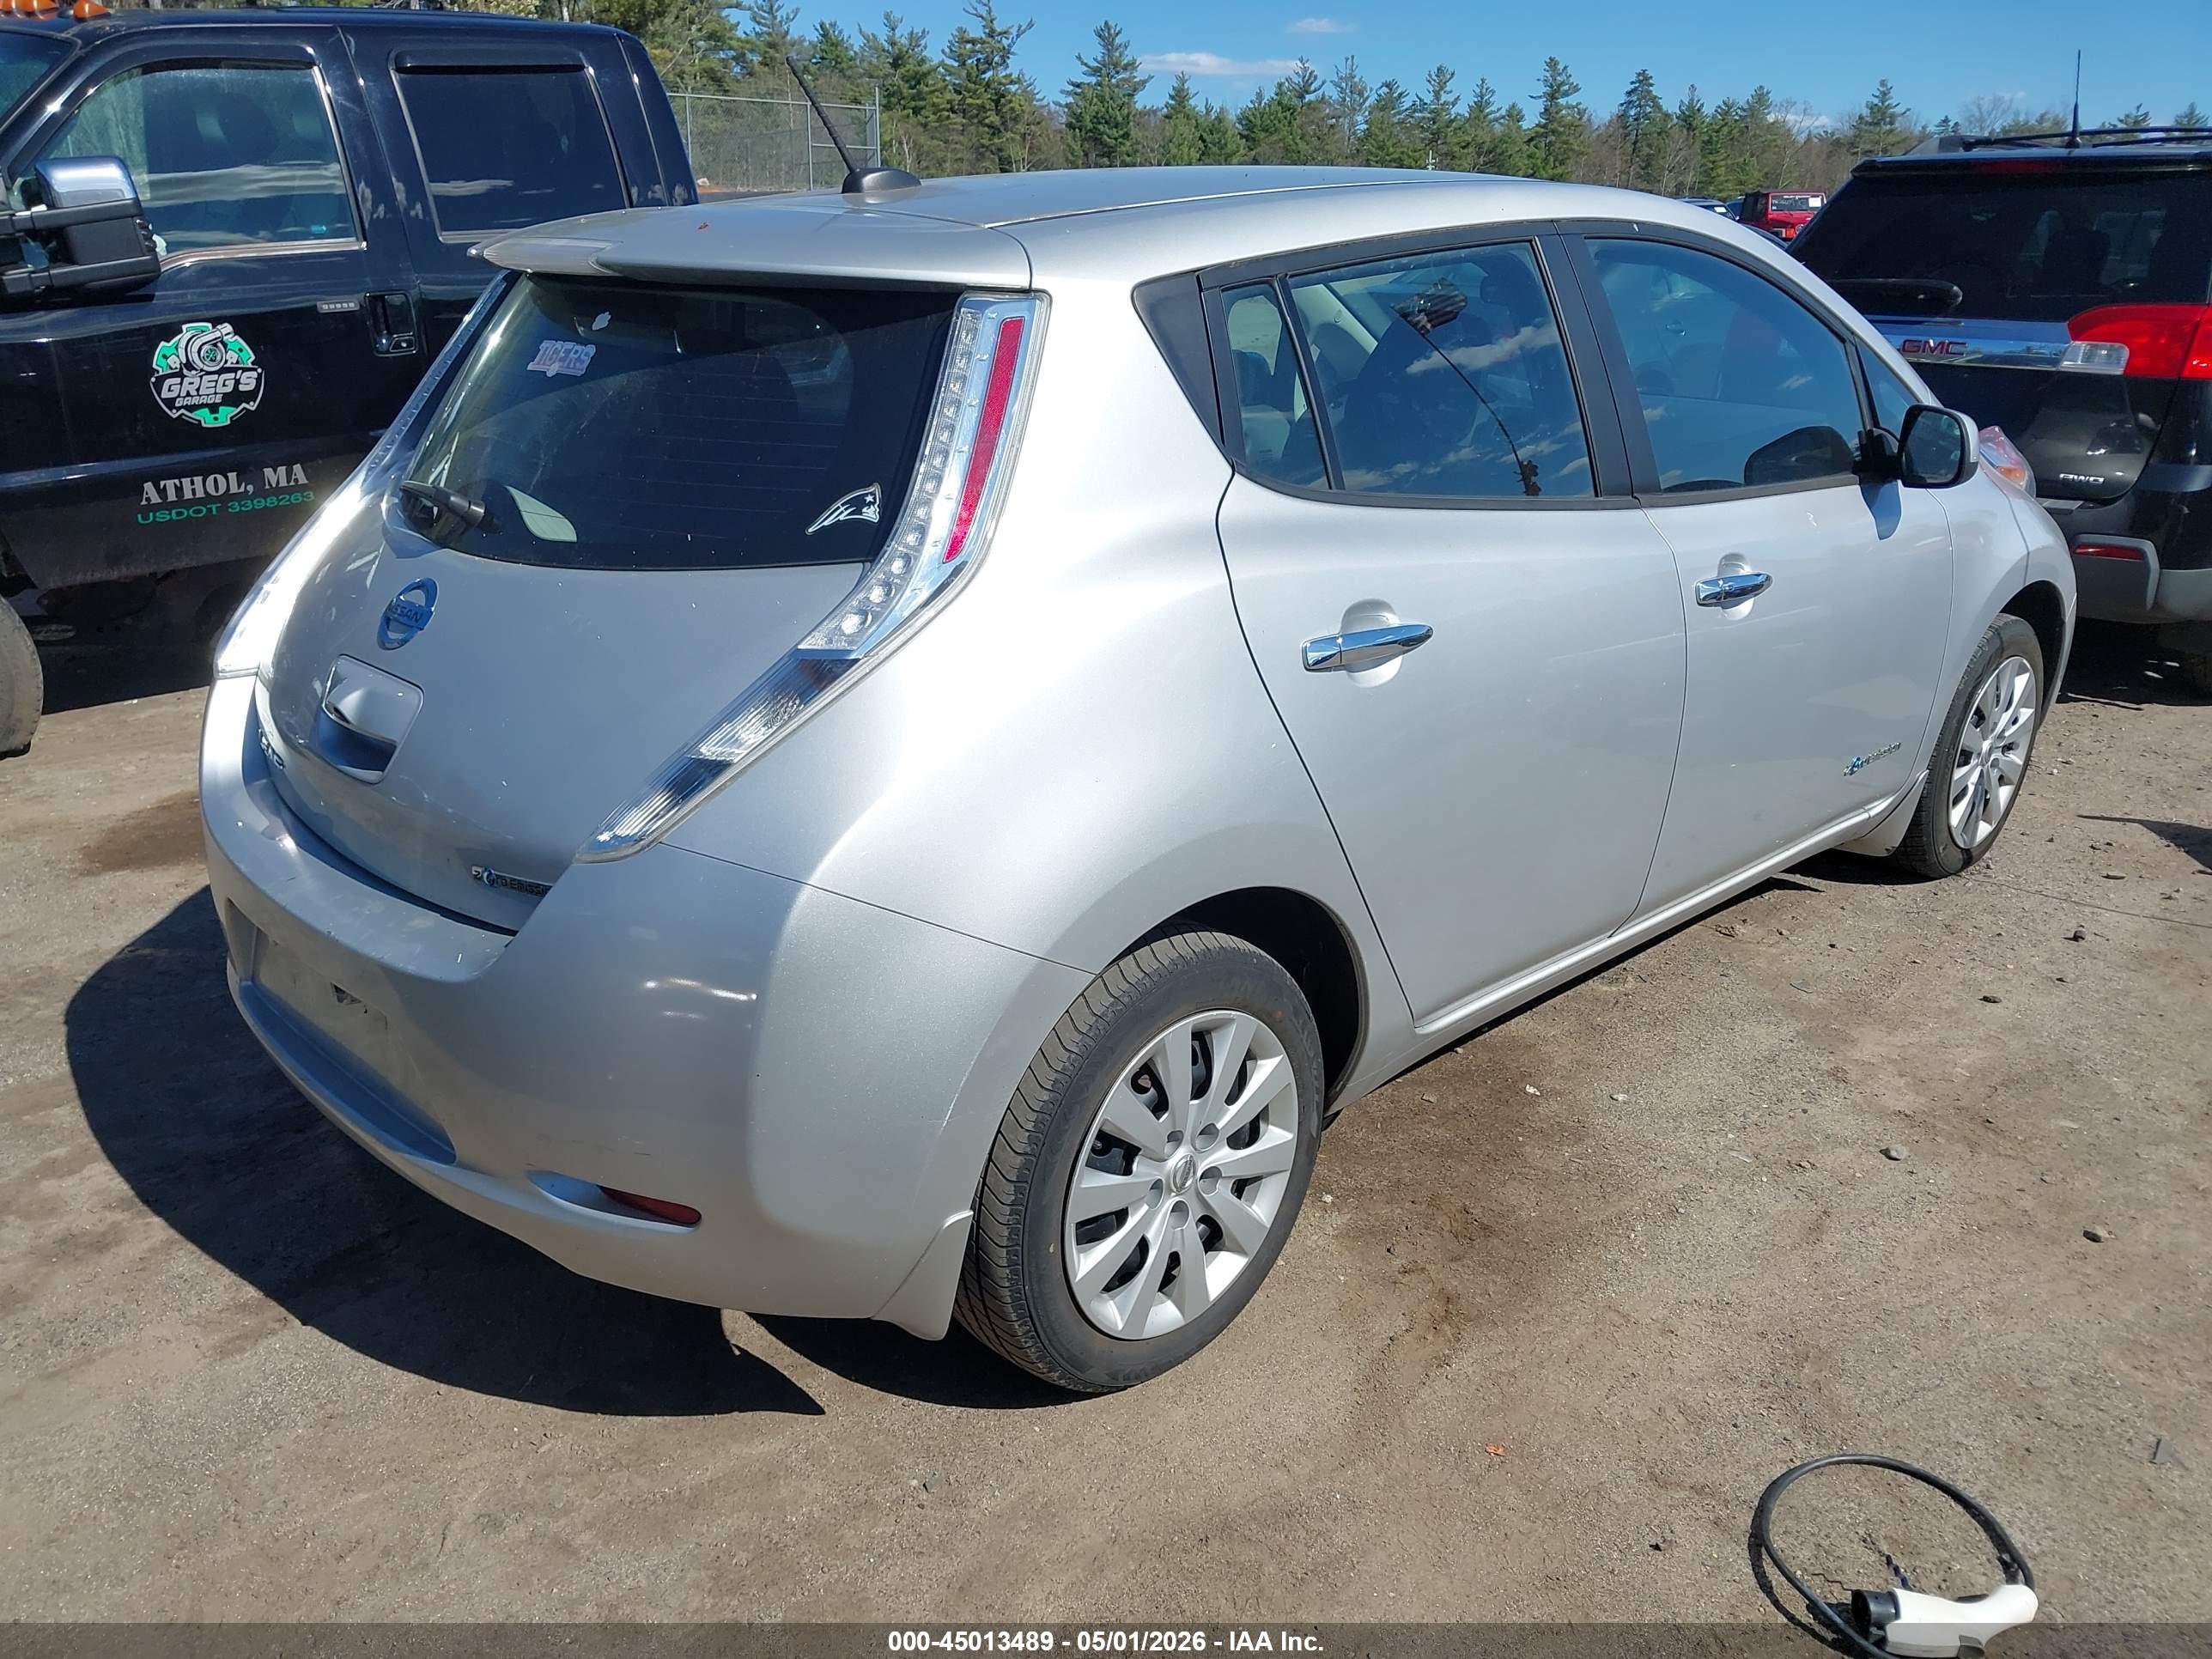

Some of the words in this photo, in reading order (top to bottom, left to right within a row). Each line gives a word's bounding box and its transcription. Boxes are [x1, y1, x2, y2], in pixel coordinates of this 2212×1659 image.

[1901, 339, 1967, 356] GMC
[161, 370, 258, 398] GREG'S
[175, 394, 223, 407] GARAGE
[140, 472, 254, 505] ATHOL,
[263, 464, 309, 489] MA
[137, 504, 222, 524] USDOT
[228, 491, 315, 513] 3398263
